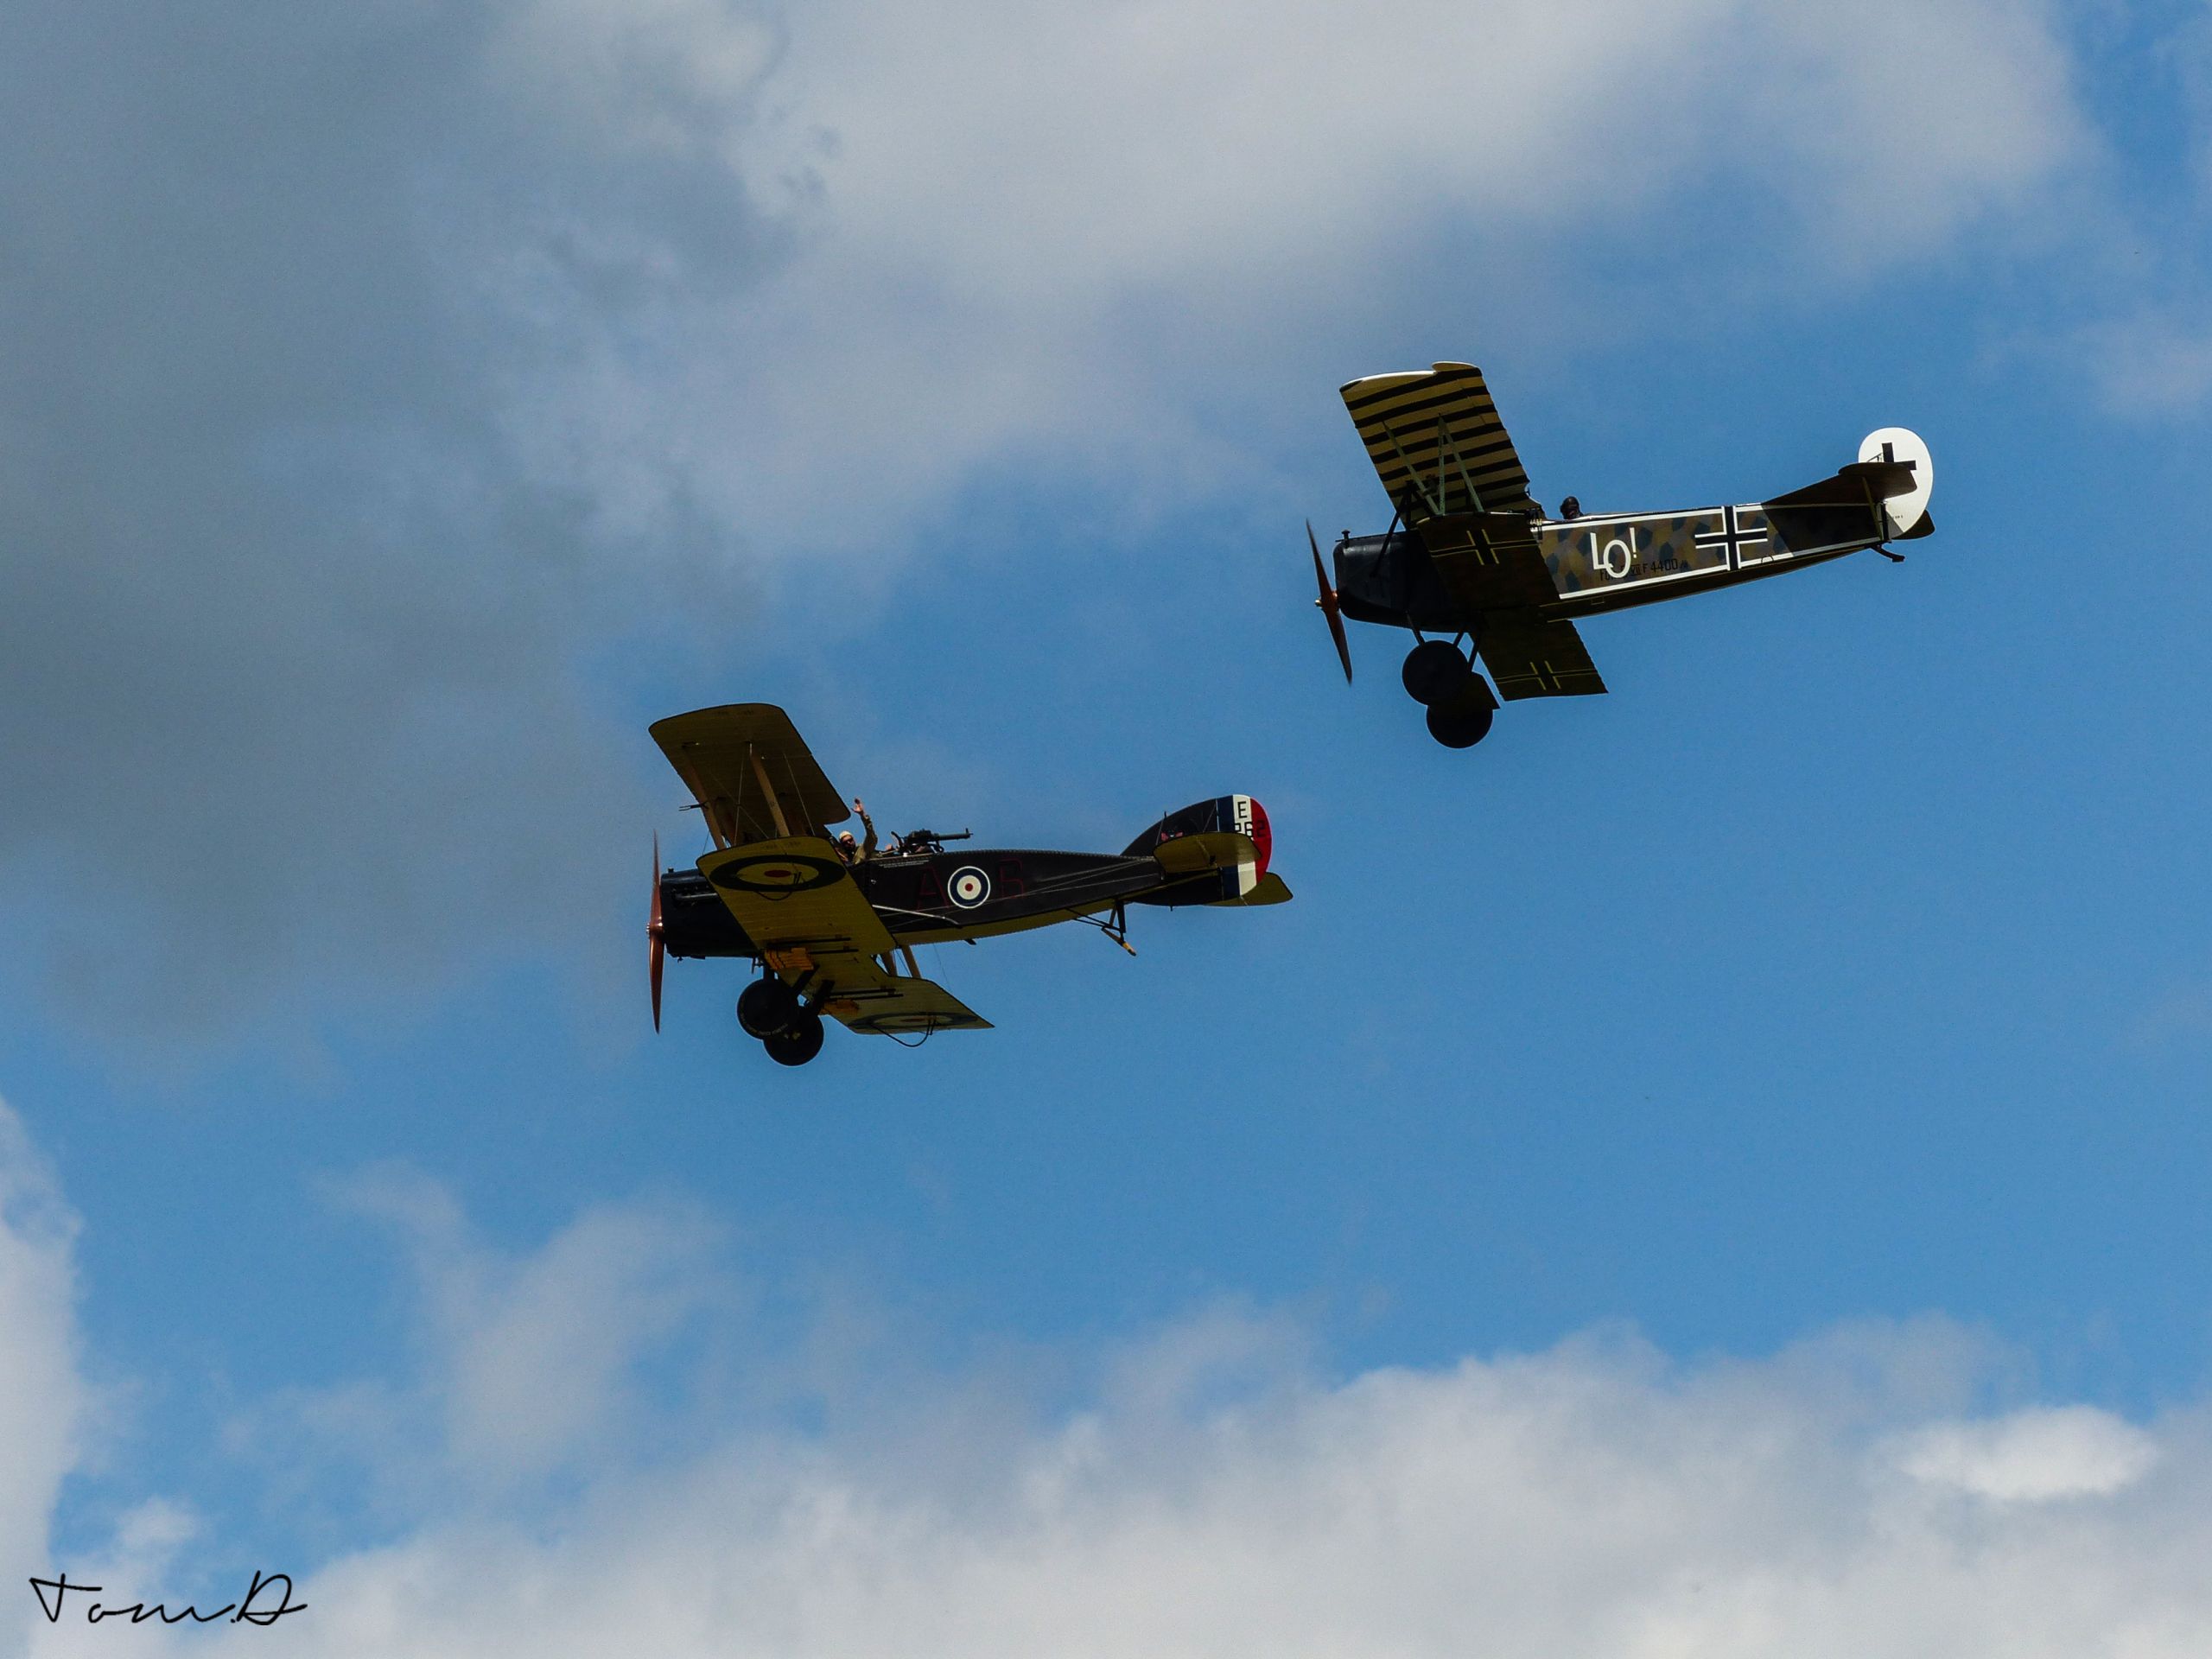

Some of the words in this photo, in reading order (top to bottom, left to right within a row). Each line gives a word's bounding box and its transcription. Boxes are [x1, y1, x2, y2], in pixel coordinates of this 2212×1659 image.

[1590, 526, 1637, 579] LO!
[1650, 558, 1678, 573] 4400
[1237, 801, 1247, 818] E
